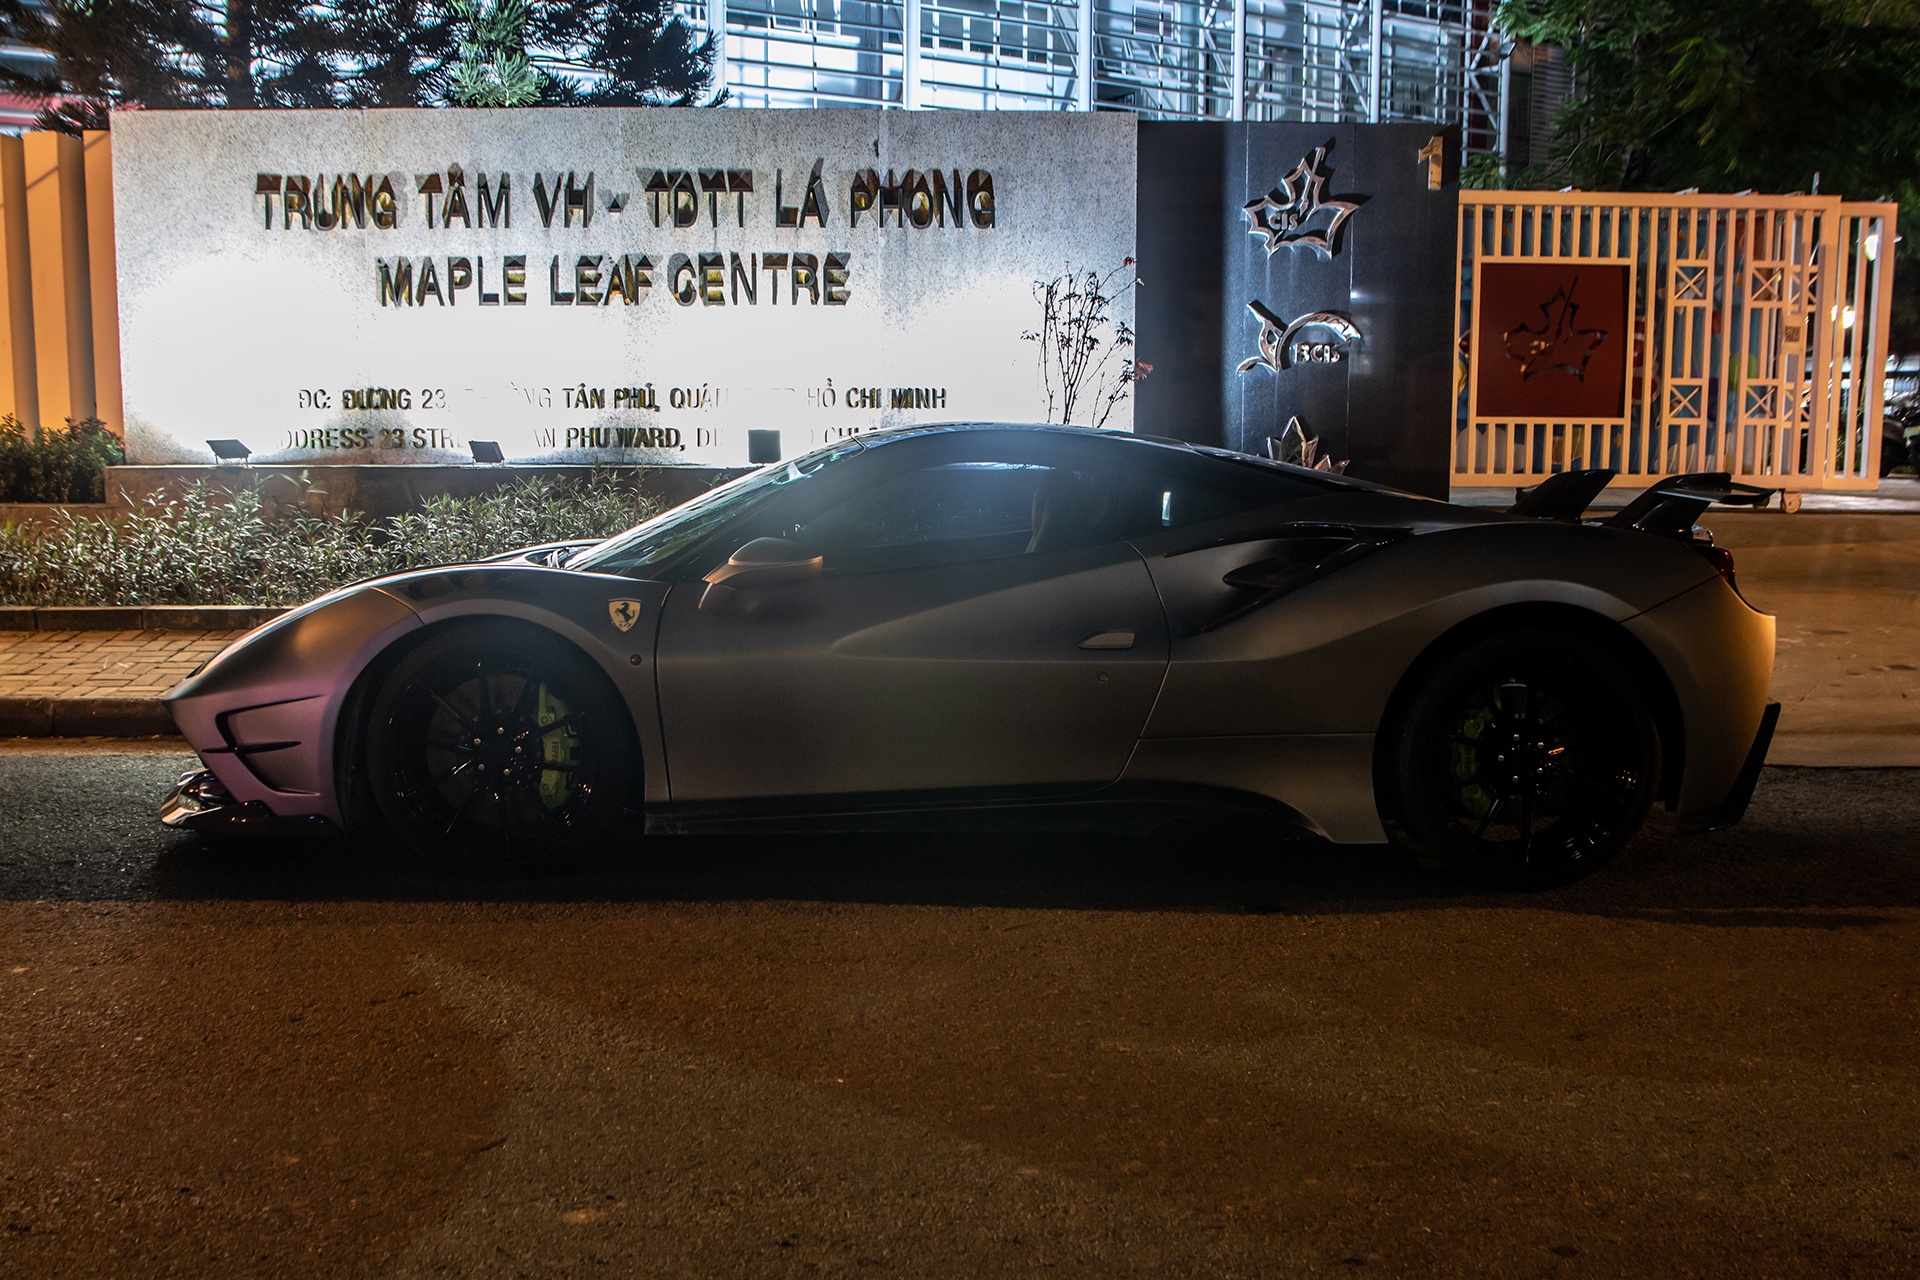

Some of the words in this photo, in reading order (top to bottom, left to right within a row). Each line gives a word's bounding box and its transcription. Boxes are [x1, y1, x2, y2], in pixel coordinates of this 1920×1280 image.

[1418, 136, 1444, 190] 1
[255, 182, 397, 231] TRUNG
[418, 171, 511, 229] TÂM
[533, 180, 590, 229] VH
[644, 180, 753, 229] TDTT
[775, 170, 828, 229] LÁ
[850, 180, 996, 230] PHONG
[378, 261, 528, 307] MAPLE
[550, 261, 653, 307] LEAF
[672, 261, 850, 307] CENTRE
[890, 387, 947, 409] MINH
[379, 428, 405, 450] 23
[566, 427, 612, 449] PHU
